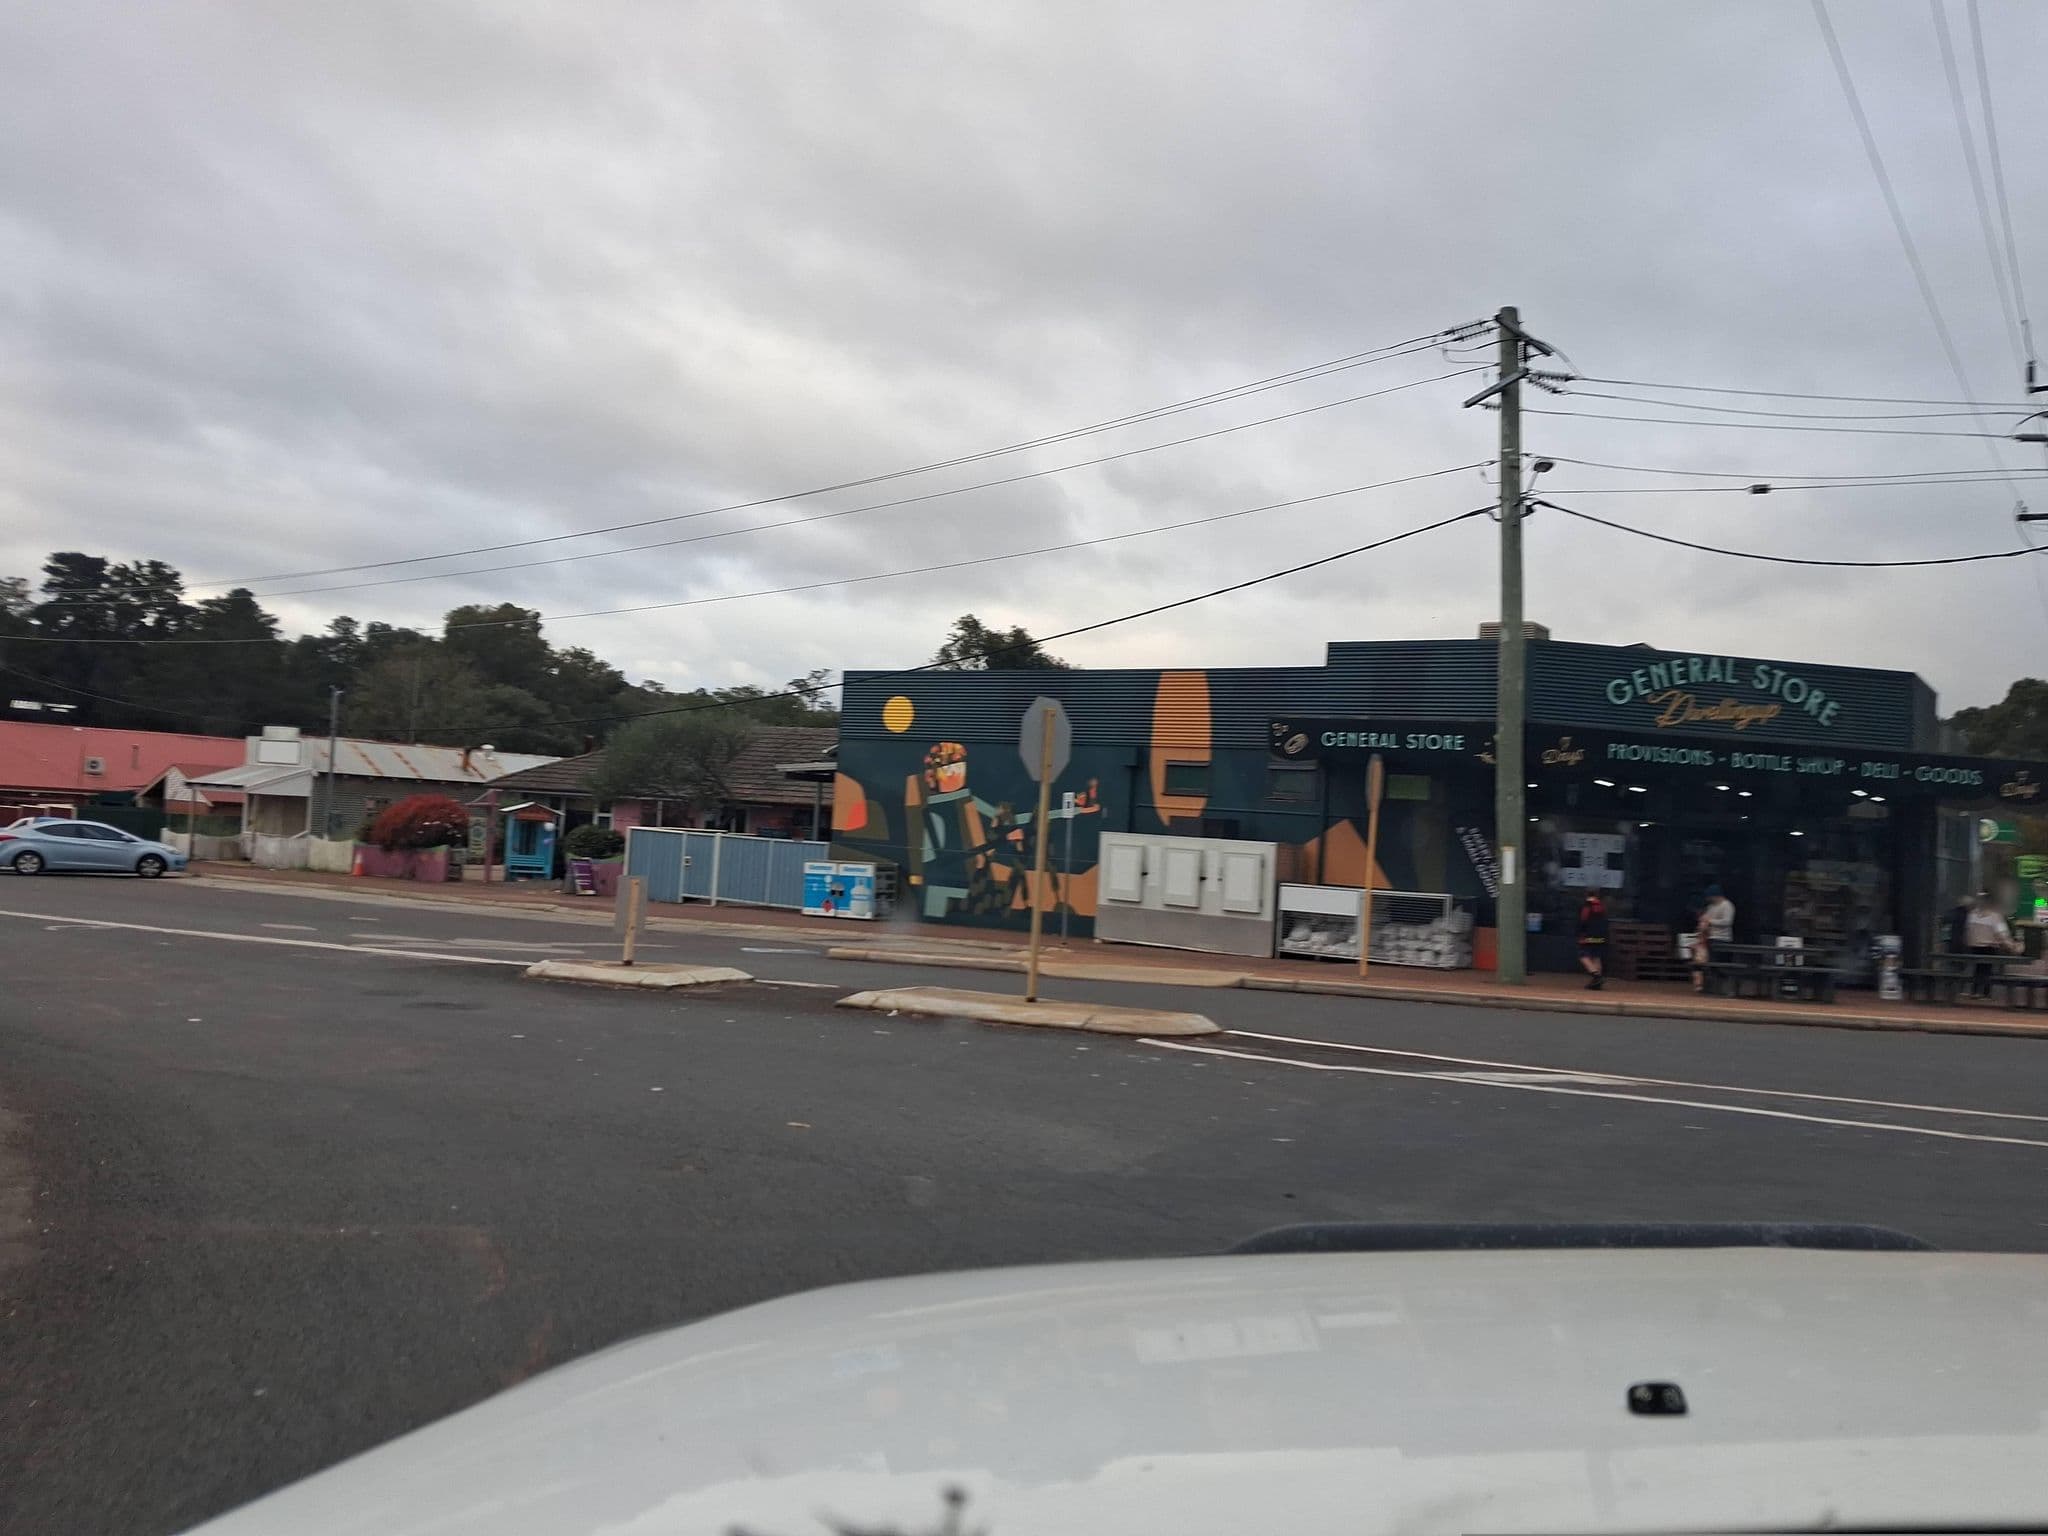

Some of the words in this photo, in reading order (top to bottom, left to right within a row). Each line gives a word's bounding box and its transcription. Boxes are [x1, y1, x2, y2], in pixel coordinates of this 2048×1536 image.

[1606, 657, 1739, 705] GENERAL
[1752, 664, 1840, 727] STORE
[1320, 731, 1400, 748] GENERAL
[1405, 734, 1465, 750] STORE
[1607, 743, 1715, 766] PROVISIONS
[1731, 752, 1792, 771] BOTTLE
[1797, 757, 1845, 776] SHOP
[1915, 765, 1984, 786] GOODS
